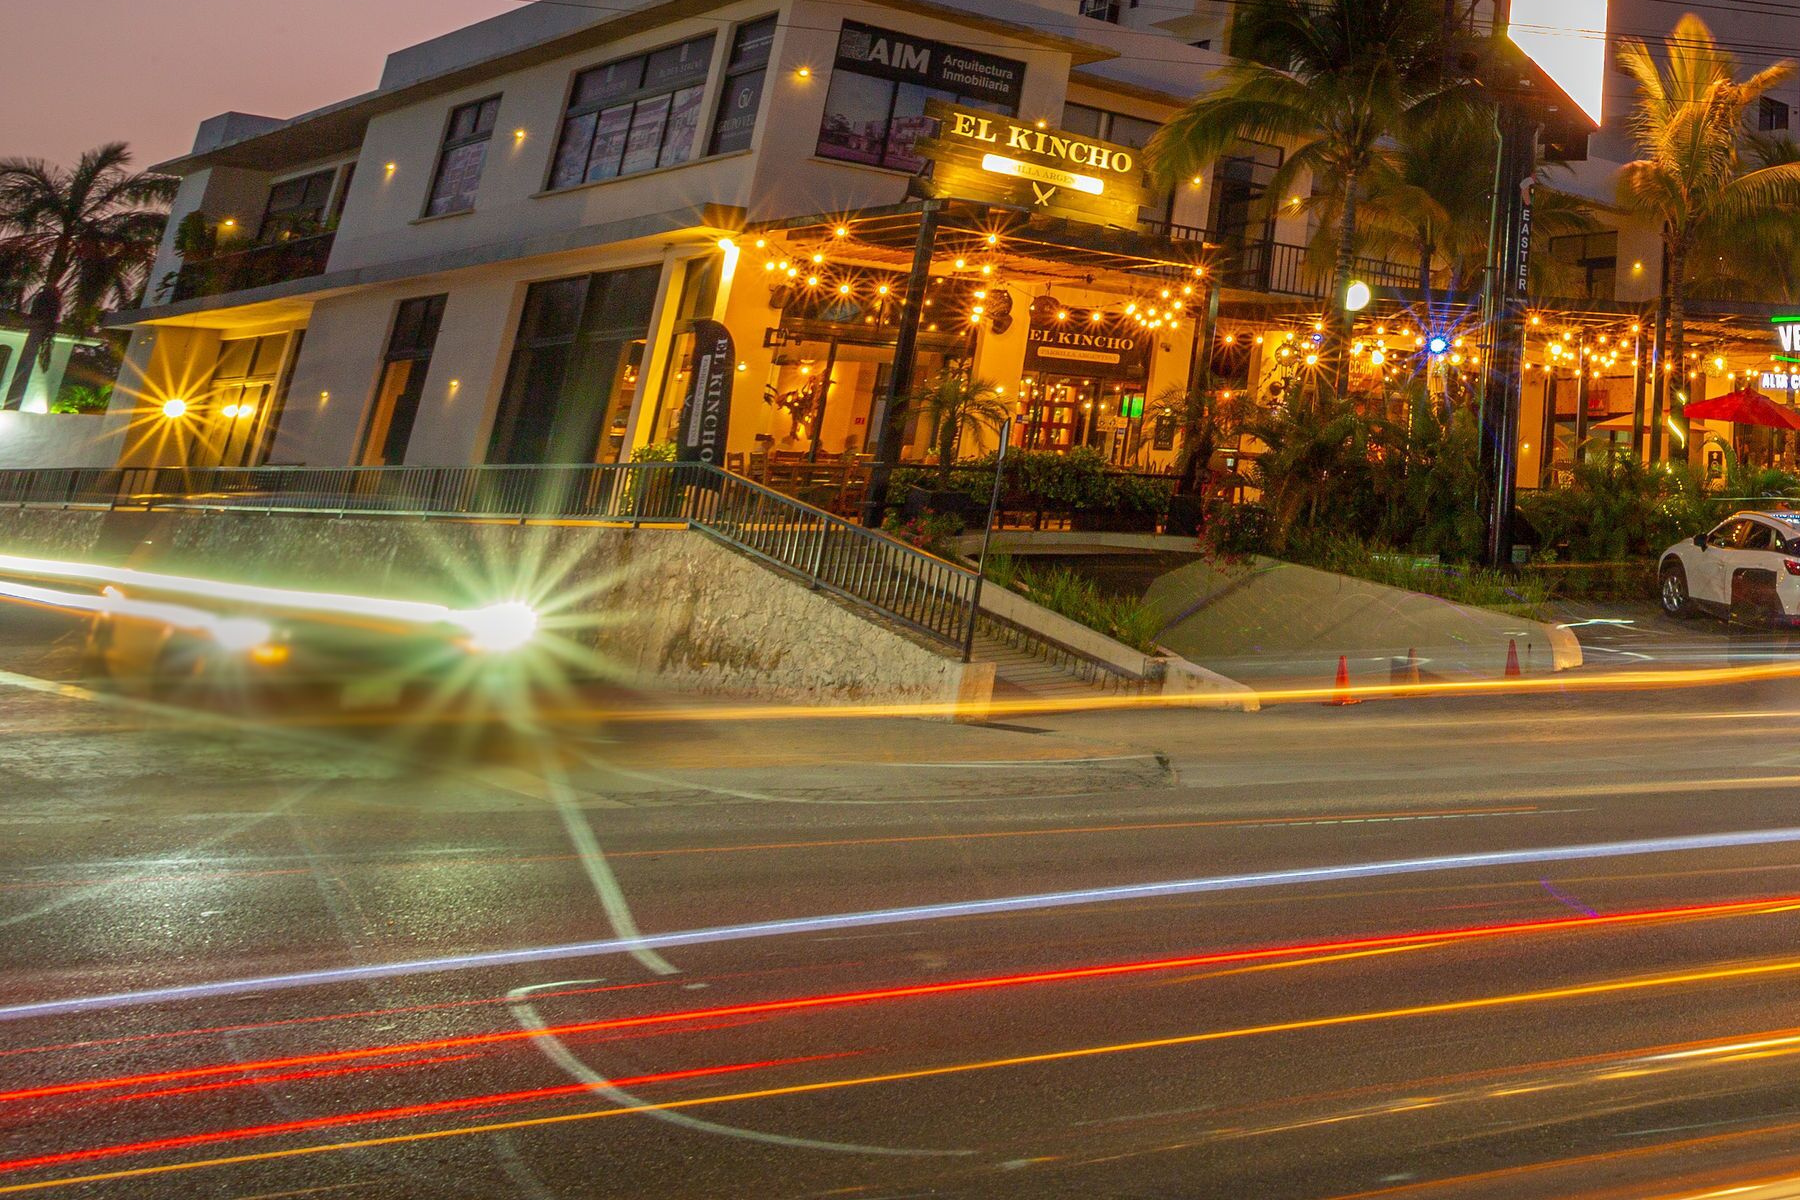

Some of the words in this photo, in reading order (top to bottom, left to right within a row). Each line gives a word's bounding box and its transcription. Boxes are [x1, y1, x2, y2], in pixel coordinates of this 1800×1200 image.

[868, 38, 931, 74] AIM
[943, 54, 1013, 80] Arquitectura
[942, 67, 1010, 93] Inmobiliaria
[951, 112, 997, 142] EL
[1006, 125, 1133, 173] KINCHO
[1518, 209, 1530, 290] EASTER
[714, 338, 728, 365] EL
[1029, 329, 1053, 342] EL
[1058, 332, 1134, 350] KINCHO
[700, 373, 723, 462] KINCHO
